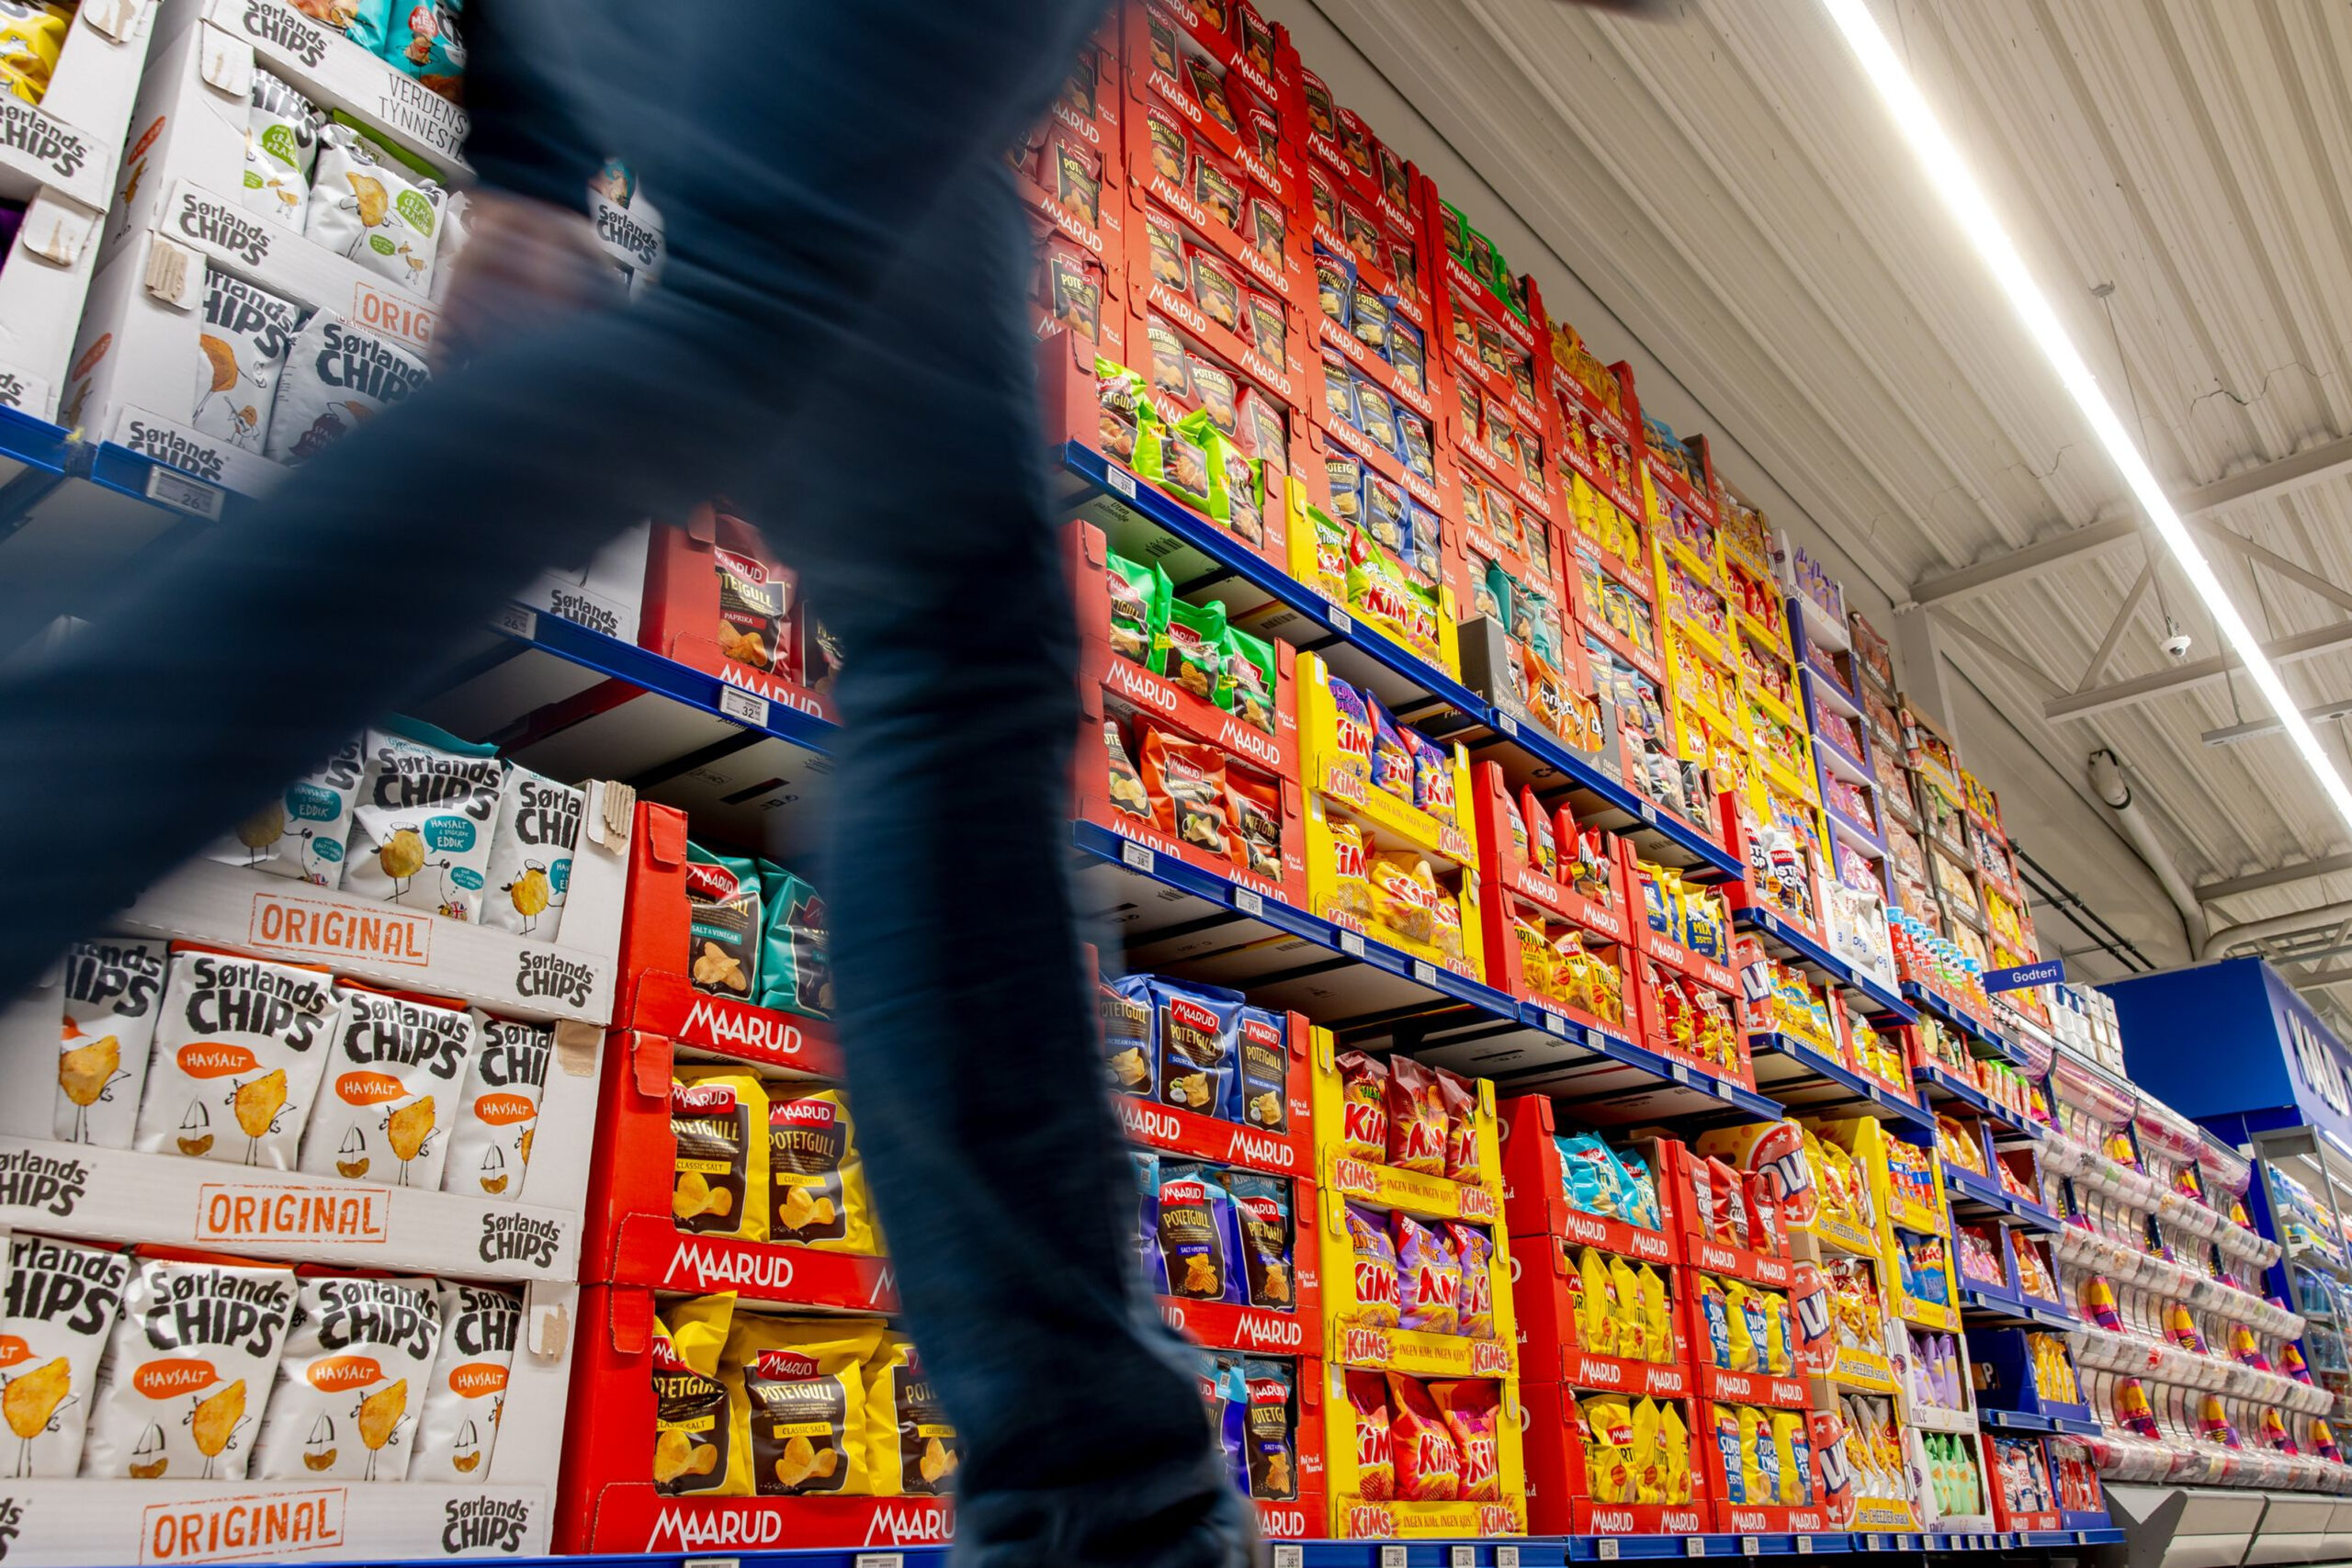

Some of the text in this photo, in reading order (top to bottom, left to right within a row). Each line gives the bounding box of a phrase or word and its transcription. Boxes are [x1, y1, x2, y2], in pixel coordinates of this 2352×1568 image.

[243, 11, 324, 67] CHIPS
[1230, 52, 1278, 102] MAARUD
[389, 73, 468, 134] VERDENS
[1149, 71, 1203, 124] MAARUD
[379, 96, 463, 163] TYNNESTE
[1234, 145, 1282, 195] MAARUD
[1307, 132, 1351, 177] MAARUD
[1150, 175, 1205, 227] MAARUD
[1376, 194, 1415, 235] MAARUD
[183, 194, 271, 248] Sørlands
[599, 204, 658, 250] Sørlands
[1041, 197, 1103, 253] MAARUD
[179, 212, 267, 266] CHIPS
[597, 220, 656, 265] CHIPS
[1313, 221, 1356, 265] MAARUD
[1239, 245, 1289, 292] MAARUD
[1446, 257, 1482, 297] MAARUD
[1148, 283, 1206, 333] MAARUD
[1319, 318, 1364, 361] MAARUD
[1502, 310, 1535, 346] MAARUD
[1241, 349, 1292, 395] MAARUD
[1455, 344, 1490, 382] MAARUD
[1553, 363, 1584, 397] MAARUD
[1391, 375, 1432, 414] MAARUD
[1510, 395, 1542, 430] MAARUD
[1601, 408, 1630, 438] MAARUD
[130, 421, 224, 472] Sørlands
[1329, 416, 1374, 458] MAARUD
[1461, 434, 1497, 470] MAARUD
[1563, 446, 1593, 477] MAARUD
[1646, 453, 1674, 483] MAARUD
[1401, 470, 1442, 509] MAARUD
[1518, 480, 1551, 514] MAARUD
[1611, 485, 1640, 517] MAARUD
[1689, 491, 1713, 519] MAARUD
[1466, 527, 1502, 562] MAARUD
[1572, 527, 1602, 560] MAARUD
[1524, 570, 1557, 604] MAARUD
[1620, 567, 1649, 596] MAARUD
[551, 588, 618, 629] Sørlands
[724, 612, 753, 625] PAPRIKA
[1586, 612, 1616, 644] MAARUD
[1634, 650, 1662, 679] MAARUD
[1106, 659, 1177, 711] MAARUD
[741, 705, 754, 718] 32
[1219, 718, 1280, 765] MAARUD
[381, 748, 501, 789] Sørlands
[1170, 759, 1201, 780] MAARUD
[300, 806, 330, 818] EDDIK
[373, 775, 501, 820] CHIPS
[431, 818, 468, 830] HAVSALT
[437, 837, 465, 849] EDDIK
[1517, 870, 1558, 904] MAARUD
[261, 904, 424, 958] ORIGINAL
[691, 924, 709, 935] SALT
[712, 930, 740, 943] VINEGAR
[1583, 903, 1620, 934] MAARUD
[1692, 921, 1712, 936] MIX
[1520, 941, 1542, 954] MIX
[1650, 935, 1684, 964] MAARUD
[194, 957, 329, 1013] Sørlands
[519, 951, 594, 985] Sørlands
[1704, 963, 1735, 989] MAARUD
[2012, 965, 2058, 984] Godteri
[515, 970, 593, 1008] CHIPS
[186, 988, 324, 1053] CHIPS
[351, 993, 469, 1043] Sørlands
[679, 999, 803, 1055] MAARUD
[1173, 1003, 1216, 1028] MAARUD
[345, 1021, 467, 1080] CHIPS
[1248, 1025, 1278, 1044] MAARUD
[187, 1052, 249, 1068] HAVSALT
[1246, 1045, 1282, 1072] POTETGULL
[345, 1080, 398, 1095] HAVSALT
[672, 1088, 729, 1108] MAARUD
[482, 1102, 530, 1116] HAVSALT
[769, 1103, 831, 1122] MAARUD
[1227, 1130, 1295, 1168] MAARUD
[0, 1149, 88, 1185] ørlands
[676, 1161, 724, 1172] CLASSIC SALT
[0, 1174, 85, 1217] HIPS
[1163, 1187, 1202, 1201] MAARUD
[208, 1194, 381, 1235] ORIGINAL
[482, 1213, 560, 1242] Sørlands
[1162, 1209, 1210, 1229] POTETGULL
[1565, 1213, 1606, 1242] MAARUD
[479, 1232, 560, 1269] CHIPS
[1631, 1232, 1668, 1258] MAARUD
[1702, 1245, 1736, 1269] MAARUD
[662, 1242, 794, 1288] MAARUD
[1757, 1258, 1787, 1280] MAARUD
[150, 1269, 289, 1314] Sørlands
[320, 1278, 439, 1320] Sørlands
[144, 1298, 286, 1359] CHIPS
[318, 1303, 438, 1360] CHIPS
[1234, 1313, 1302, 1347] MAARUD
[142, 1370, 209, 1388] HAVSALT
[315, 1366, 375, 1381] HAVSALT
[458, 1373, 504, 1388] HAVSALT
[761, 1355, 813, 1376] MAARUD
[1578, 1358, 1621, 1385] MAARUD
[1645, 1367, 1682, 1393] MAARUD
[1838, 1359, 1849, 1372] the
[757, 1383, 835, 1404] POTETGULL
[1715, 1373, 1751, 1397] MAARUD
[1771, 1381, 1804, 1403] MAARUD
[782, 1425, 827, 1436] CLASSIC SALT
[446, 1495, 529, 1522] Sørlands
[1403, 1516, 1423, 1529] INGEN
[1440, 1516, 1459, 1529] INGEN
[1590, 1509, 1634, 1535] MAARUD
[1660, 1510, 1700, 1535] MAARUD
[1731, 1510, 1767, 1533] MAARUD
[1788, 1511, 1821, 1532] MAARUD
[1858, 1509, 1868, 1523] the
[153, 1498, 337, 1559] ORIGINAL
[442, 1517, 527, 1554] CHIPS
[645, 1506, 782, 1553] MAARUD
[864, 1505, 956, 1548] MAARU
